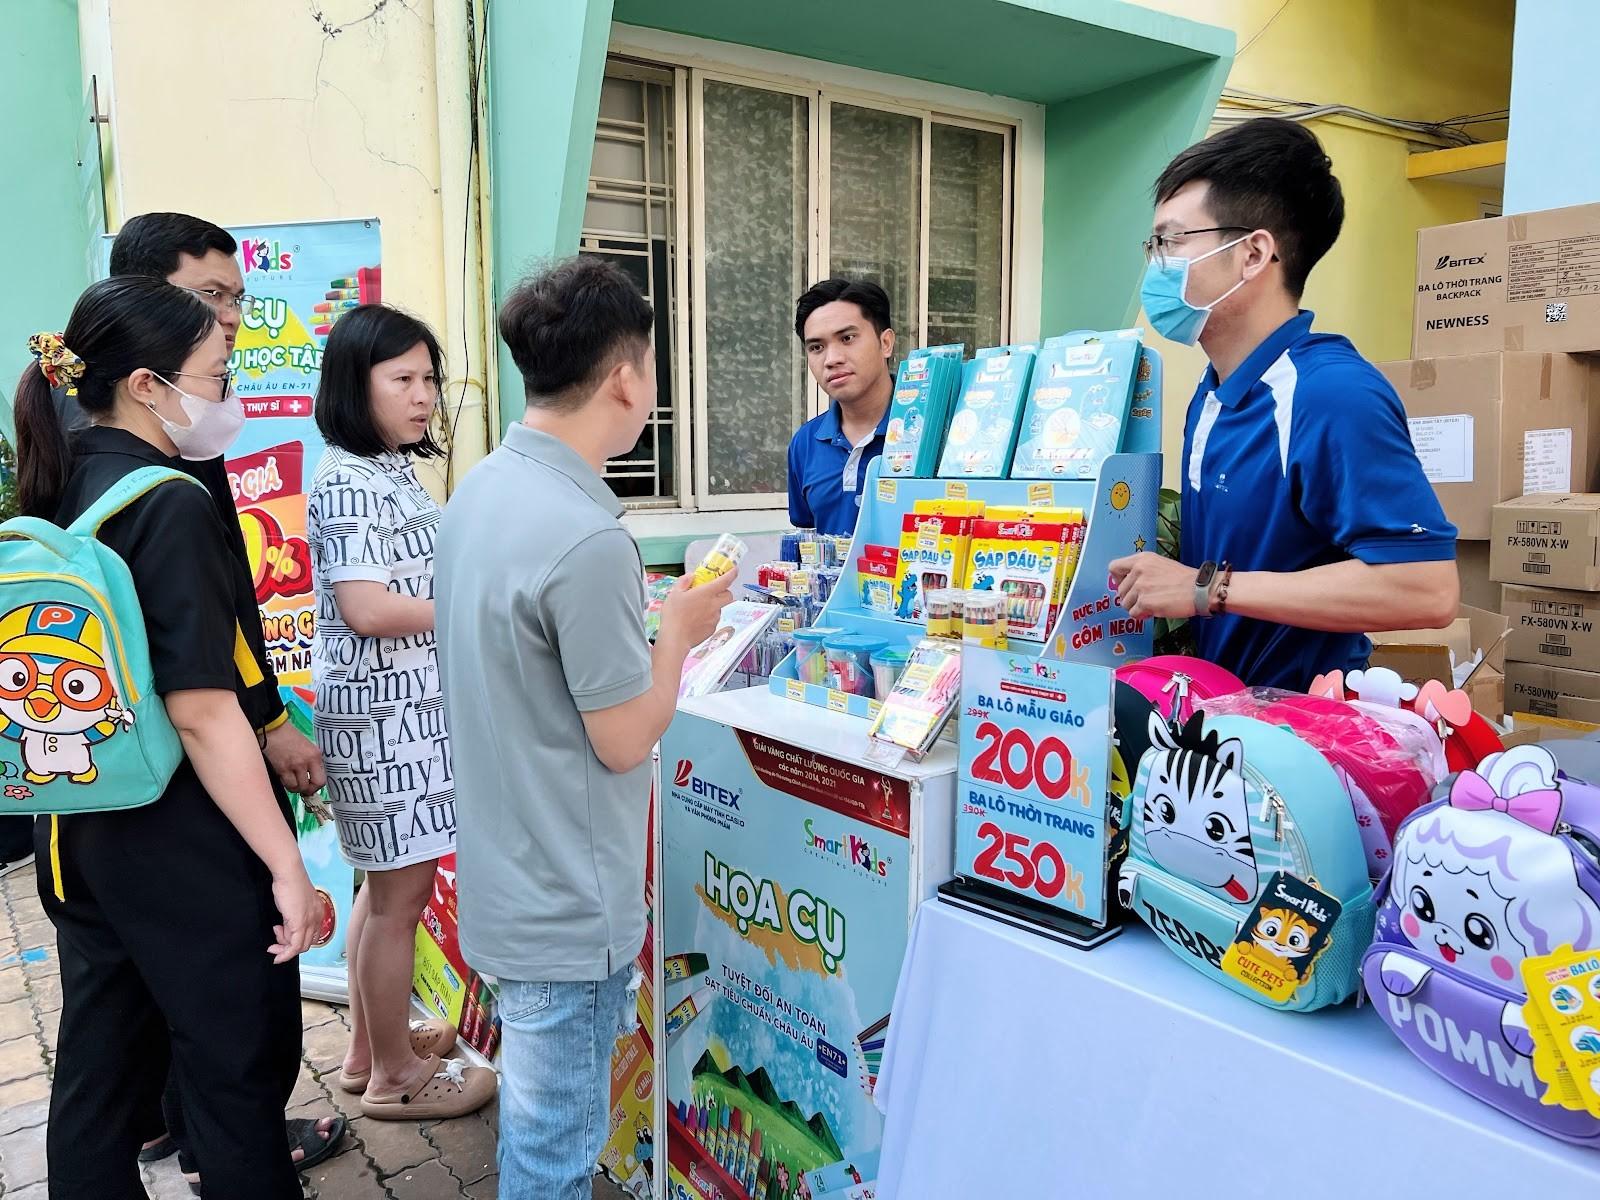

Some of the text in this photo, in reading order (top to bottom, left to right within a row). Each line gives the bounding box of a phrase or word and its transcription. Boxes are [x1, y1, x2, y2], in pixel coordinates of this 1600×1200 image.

[242, 239, 292, 273] Kids
[1449, 256, 1485, 268] BITEX
[1418, 284, 1430, 292] BA
[1432, 282, 1444, 290] LÔ
[1446, 278, 1468, 289] THỜI
[1469, 276, 1502, 286] TRANG
[1436, 290, 1481, 300] BACKPACK
[242, 298, 287, 338] CỤ
[1426, 314, 1488, 330] NEWNESS
[244, 346, 287, 373] HỌC
[237, 382, 262, 392] CHÂU
[265, 382, 278, 390] ÂU
[247, 402, 268, 414] THỤY
[1508, 536, 1569, 550] FX-580VN X-W
[38, 606, 76, 630] P
[260, 610, 296, 642] NG
[1110, 618, 1144, 636] NEON
[1521, 616, 1592, 632] FX-580VN X-W
[292, 650, 312, 671] NA
[1008, 658, 1035, 674] Smar
[978, 695, 1084, 728] BA LÔ MẪU GIÁO
[829, 766, 850, 781] QUỐC
[852, 774, 865, 786] GIA
[692, 777, 740, 811] BITEX
[726, 815, 745, 827] CASIO
[969, 790, 987, 807] BA
[988, 795, 1006, 813] LÔ
[1007, 800, 1042, 824] THỜI
[1044, 813, 1094, 838] TRANG
[804, 818, 886, 876] Smart Kids
[704, 850, 846, 975] HỌA CỤ
[1274, 883, 1329, 923] Smart Kids
[1237, 955, 1285, 988] CUTE PETS
[722, 963, 826, 1036] TUYỆT ĐỐI AN TOÀN
[705, 976, 814, 1049] ĐẠT TIÊU CHUẨN CHÂU ÂU
[822, 1044, 842, 1065] EN71
[1388, 992, 1538, 1099] POMM
